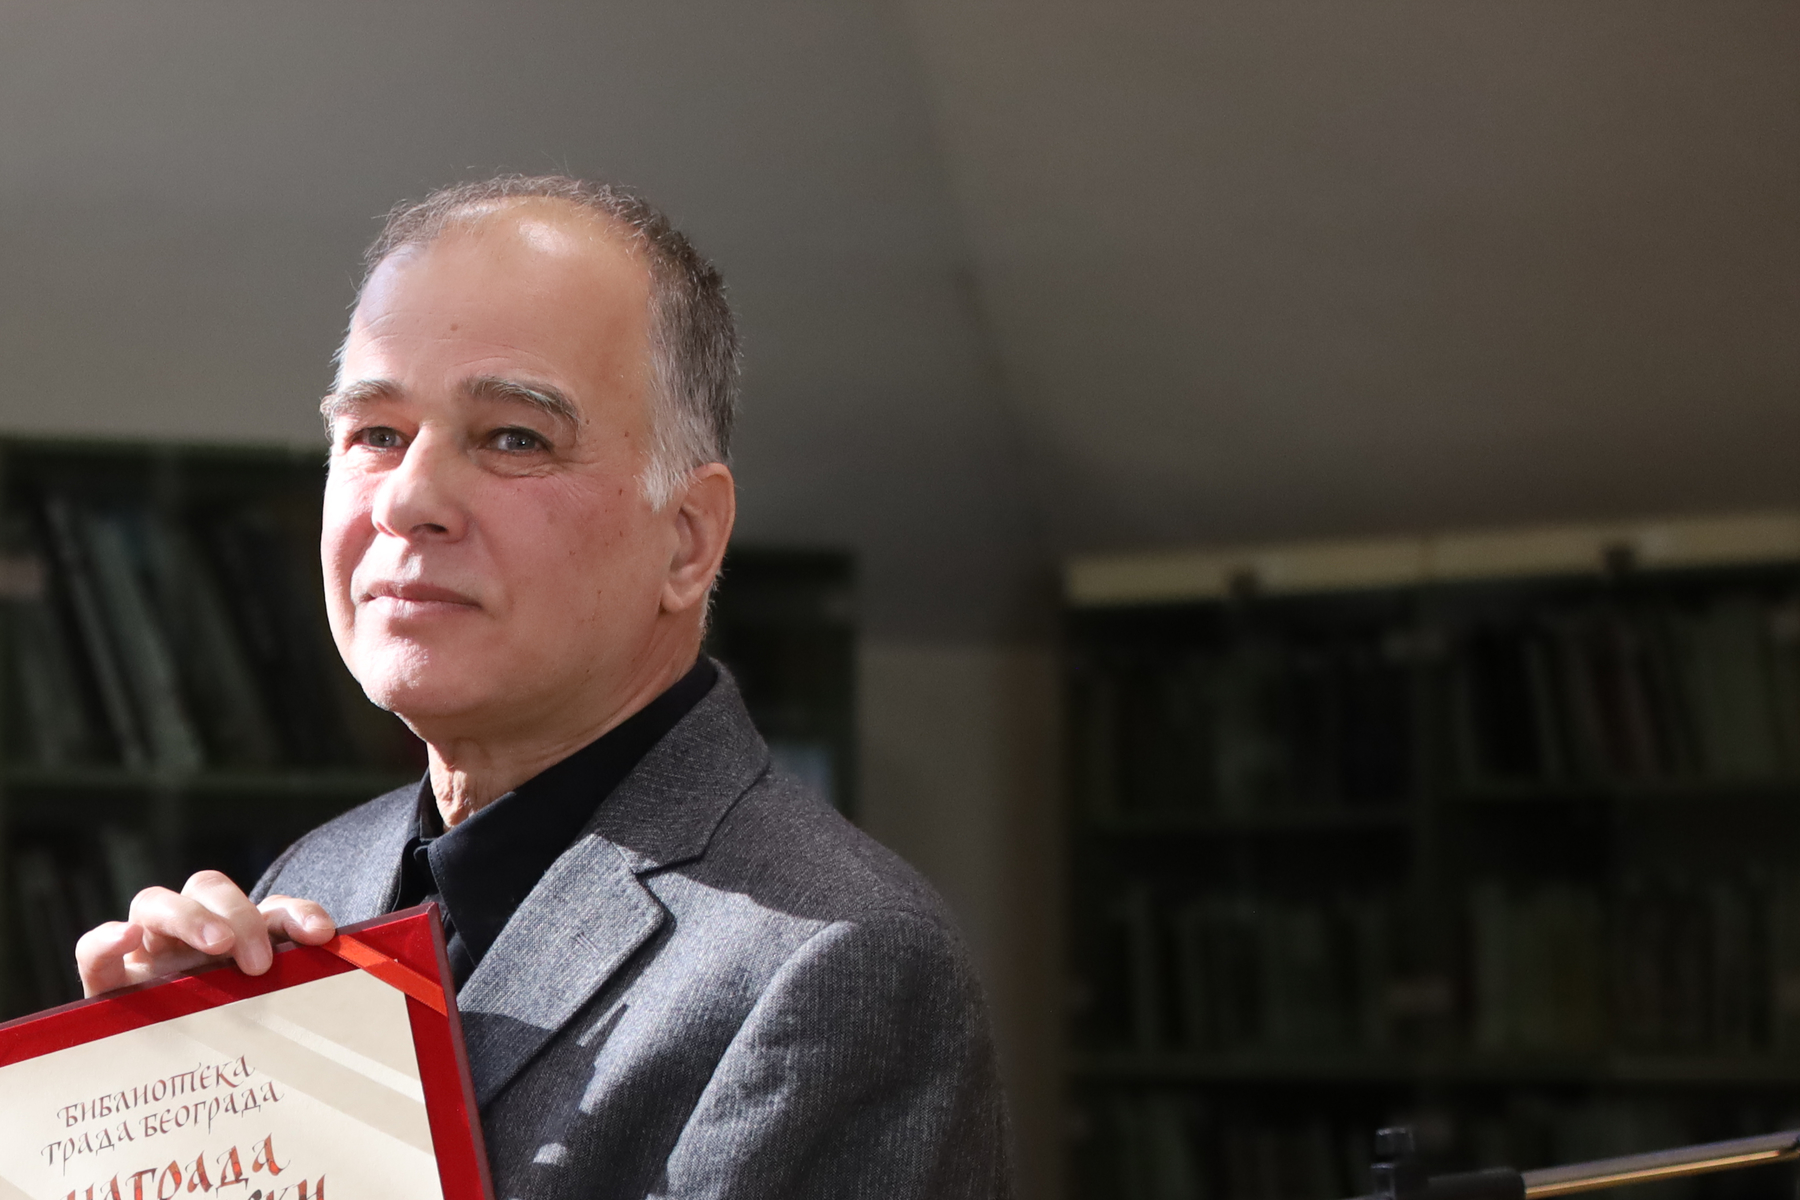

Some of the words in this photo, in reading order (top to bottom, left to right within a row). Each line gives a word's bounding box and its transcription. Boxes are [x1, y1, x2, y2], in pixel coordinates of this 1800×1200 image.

[40, 1120, 135, 1177] ГРАДА
[138, 1080, 285, 1138] БЕОГРАДА
[56, 1054, 256, 1128] БИБЛИОТЕКА
